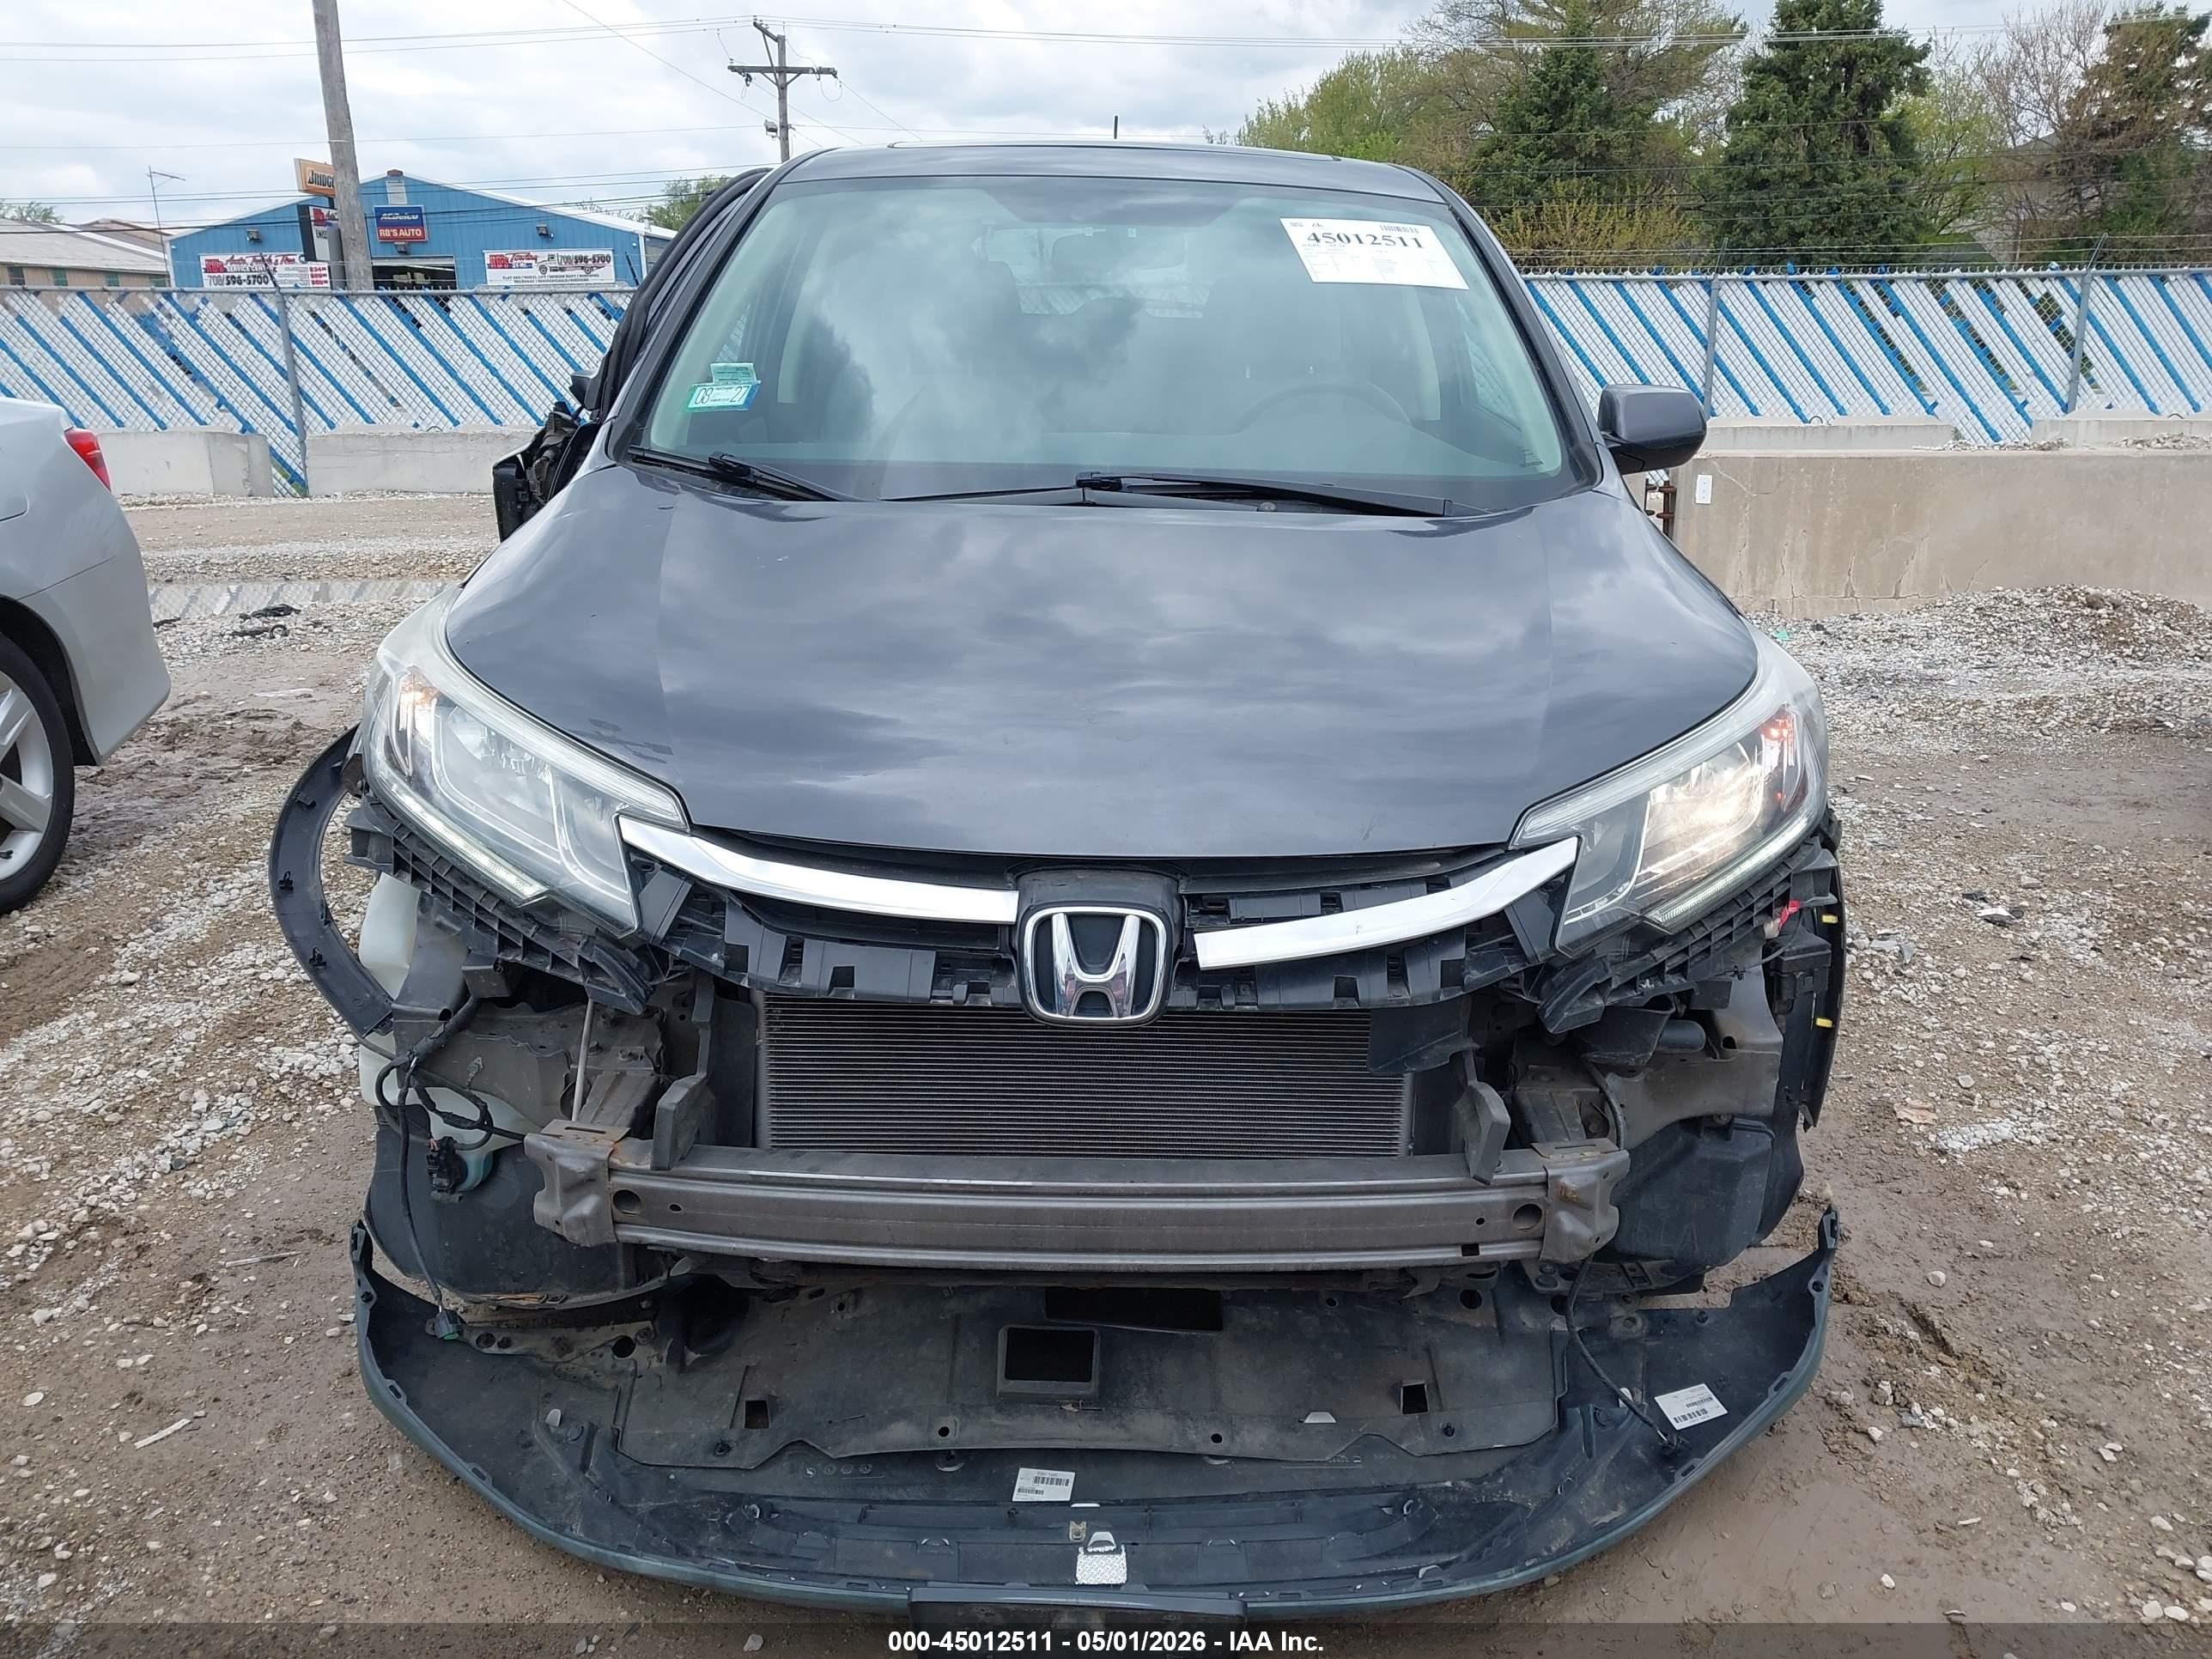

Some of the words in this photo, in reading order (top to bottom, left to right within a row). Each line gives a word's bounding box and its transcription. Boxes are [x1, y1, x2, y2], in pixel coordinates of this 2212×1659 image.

[379, 228, 398, 237] RB'S
[398, 228, 422, 237] AUTO
[1306, 232, 1425, 249] 45012511
[694, 387, 714, 404] 08
[729, 386, 750, 403] 27
